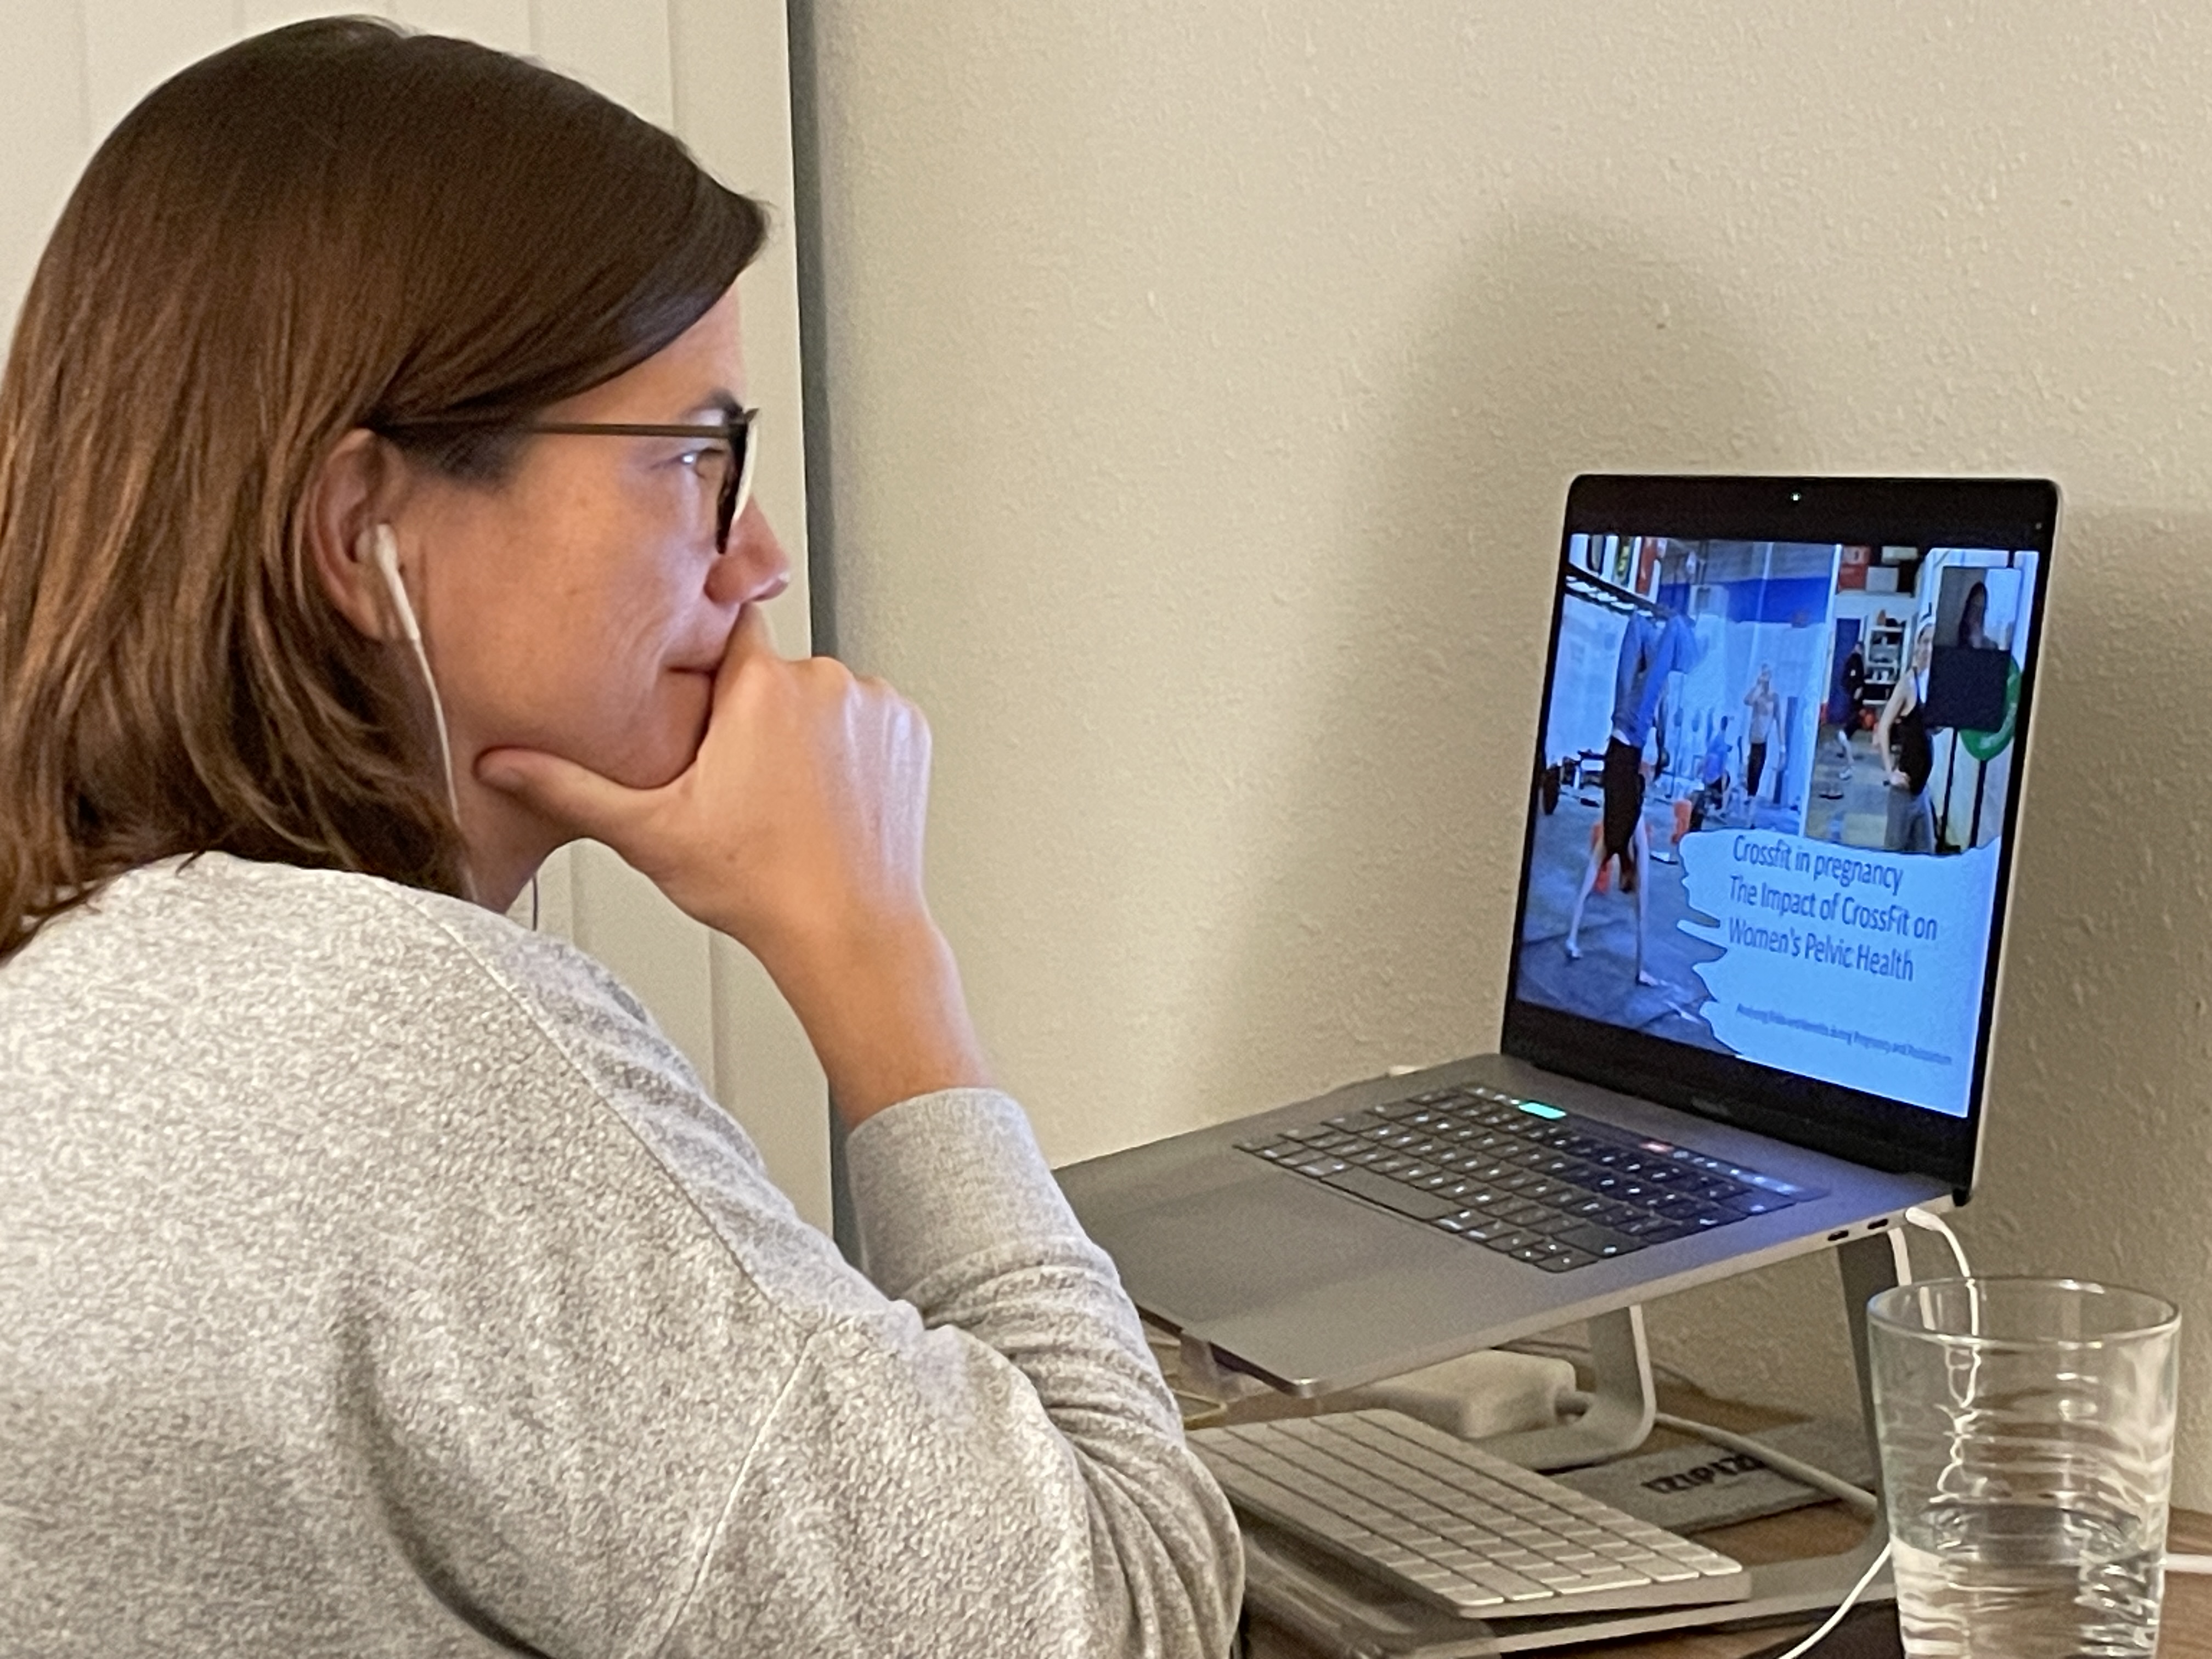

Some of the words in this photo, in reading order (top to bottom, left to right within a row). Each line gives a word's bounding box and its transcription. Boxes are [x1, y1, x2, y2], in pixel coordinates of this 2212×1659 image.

[1733, 834, 1792, 871] Crossfit
[1795, 845, 1810, 873] in
[1813, 854, 1903, 896] pregnancy
[1730, 874, 1757, 906] The
[1760, 881, 1816, 918] Impact
[1819, 892, 1841, 921] of
[1842, 896, 1910, 936] CrossFit
[1913, 916, 1938, 941] on
[1729, 916, 1801, 957] Women's
[1804, 932, 1854, 968] Pelvic
[1856, 943, 1914, 981] Health
